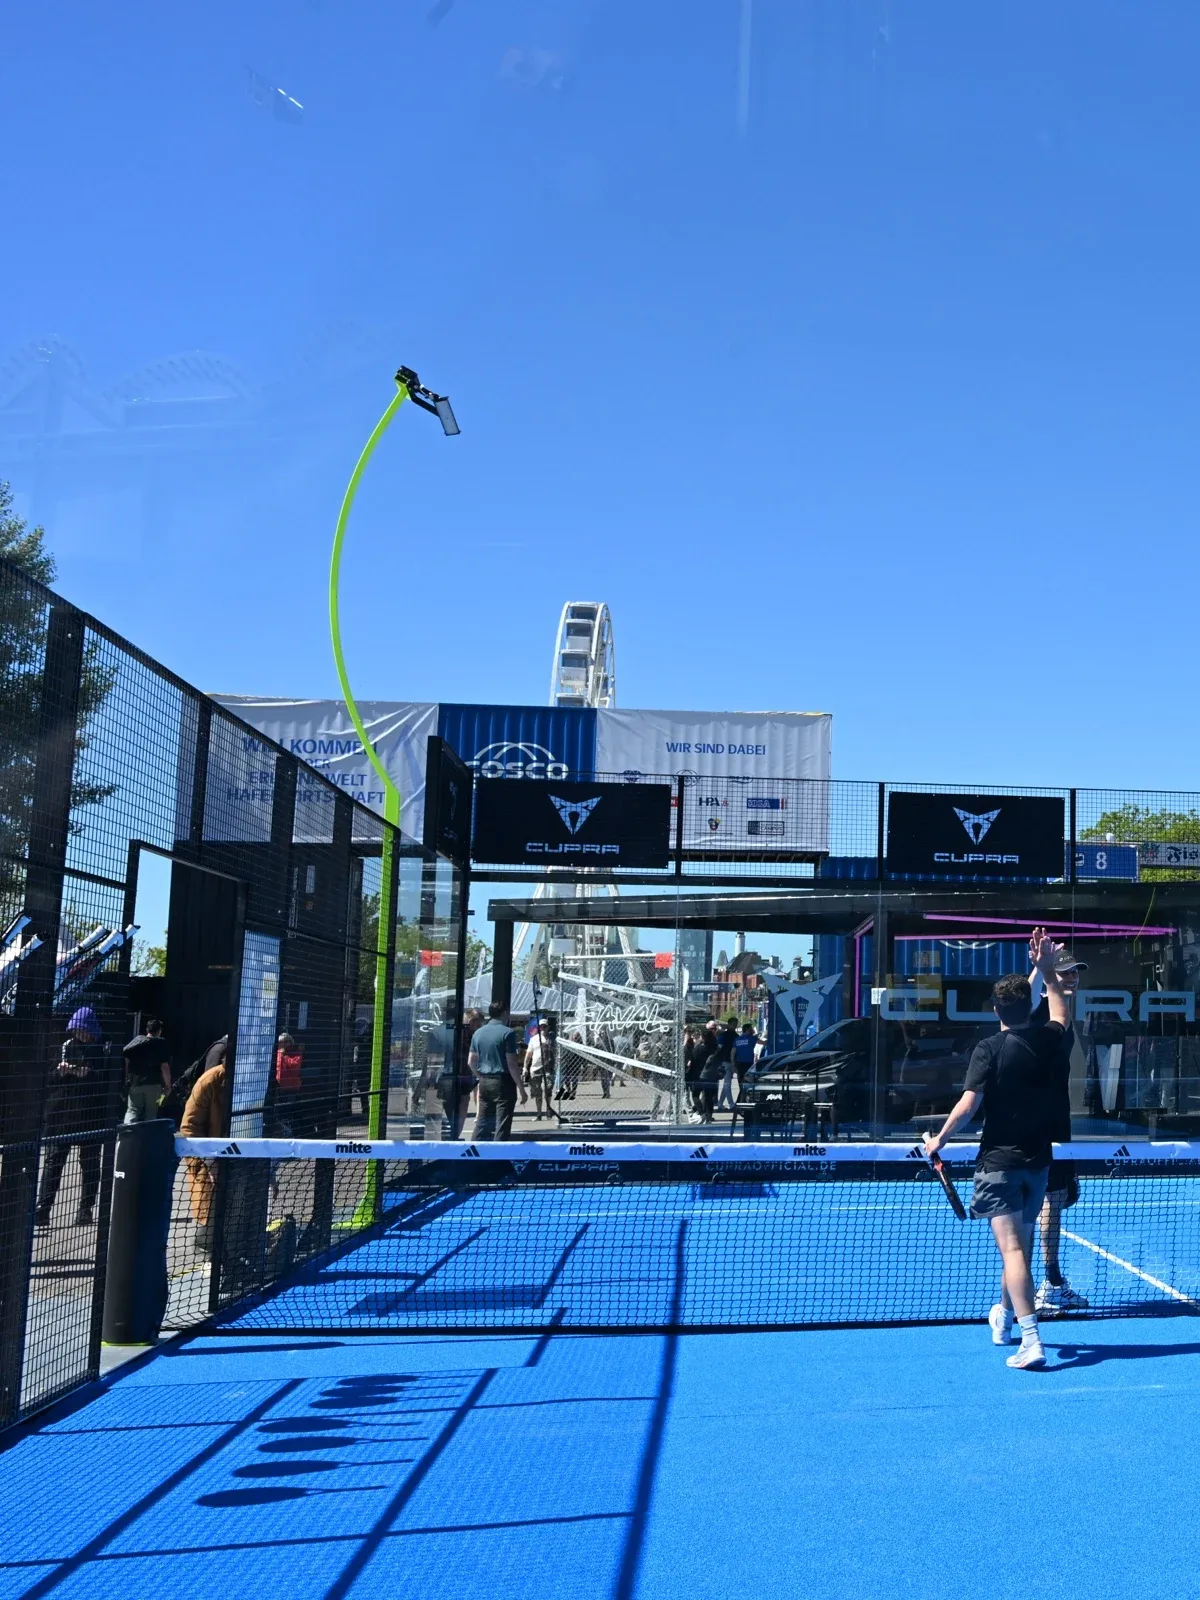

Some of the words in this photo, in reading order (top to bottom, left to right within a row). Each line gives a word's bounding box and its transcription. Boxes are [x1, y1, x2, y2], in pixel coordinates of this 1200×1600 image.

[666, 742, 690, 753] WIR
[694, 743, 725, 754] SIND
[728, 745, 766, 756] DABEI
[525, 843, 620, 855] CUPRA
[934, 852, 1019, 864] CUPRA
[880, 989, 1195, 1022] CURA
[336, 1143, 372, 1154] mitte
[569, 1143, 605, 1155] mitte
[793, 1144, 826, 1156] mitte
[539, 1163, 619, 1172] CUPRA
